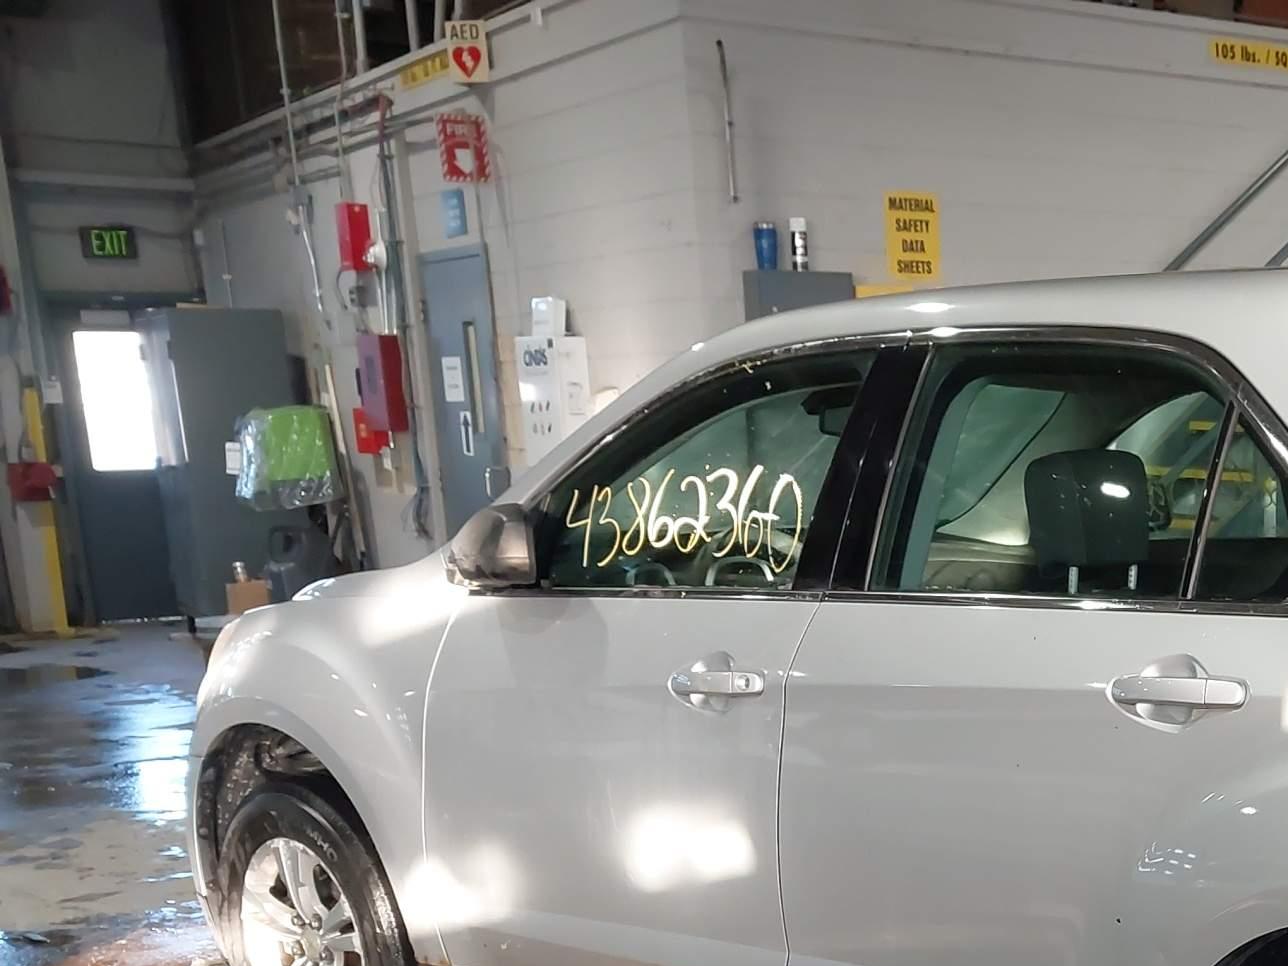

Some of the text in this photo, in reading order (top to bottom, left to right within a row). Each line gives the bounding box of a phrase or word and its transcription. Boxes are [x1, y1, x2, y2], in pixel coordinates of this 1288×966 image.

[450, 23, 480, 40] AED
[1215, 42, 1236, 60] 105
[1241, 45, 1261, 63] lbs.
[888, 197, 935, 213] MATERIAL
[895, 218, 930, 233] SAFETY
[90, 230, 128, 256] EXIT
[902, 238, 926, 253] DATA
[897, 259, 933, 275] SHEETS
[566, 463, 803, 574] 43862360
